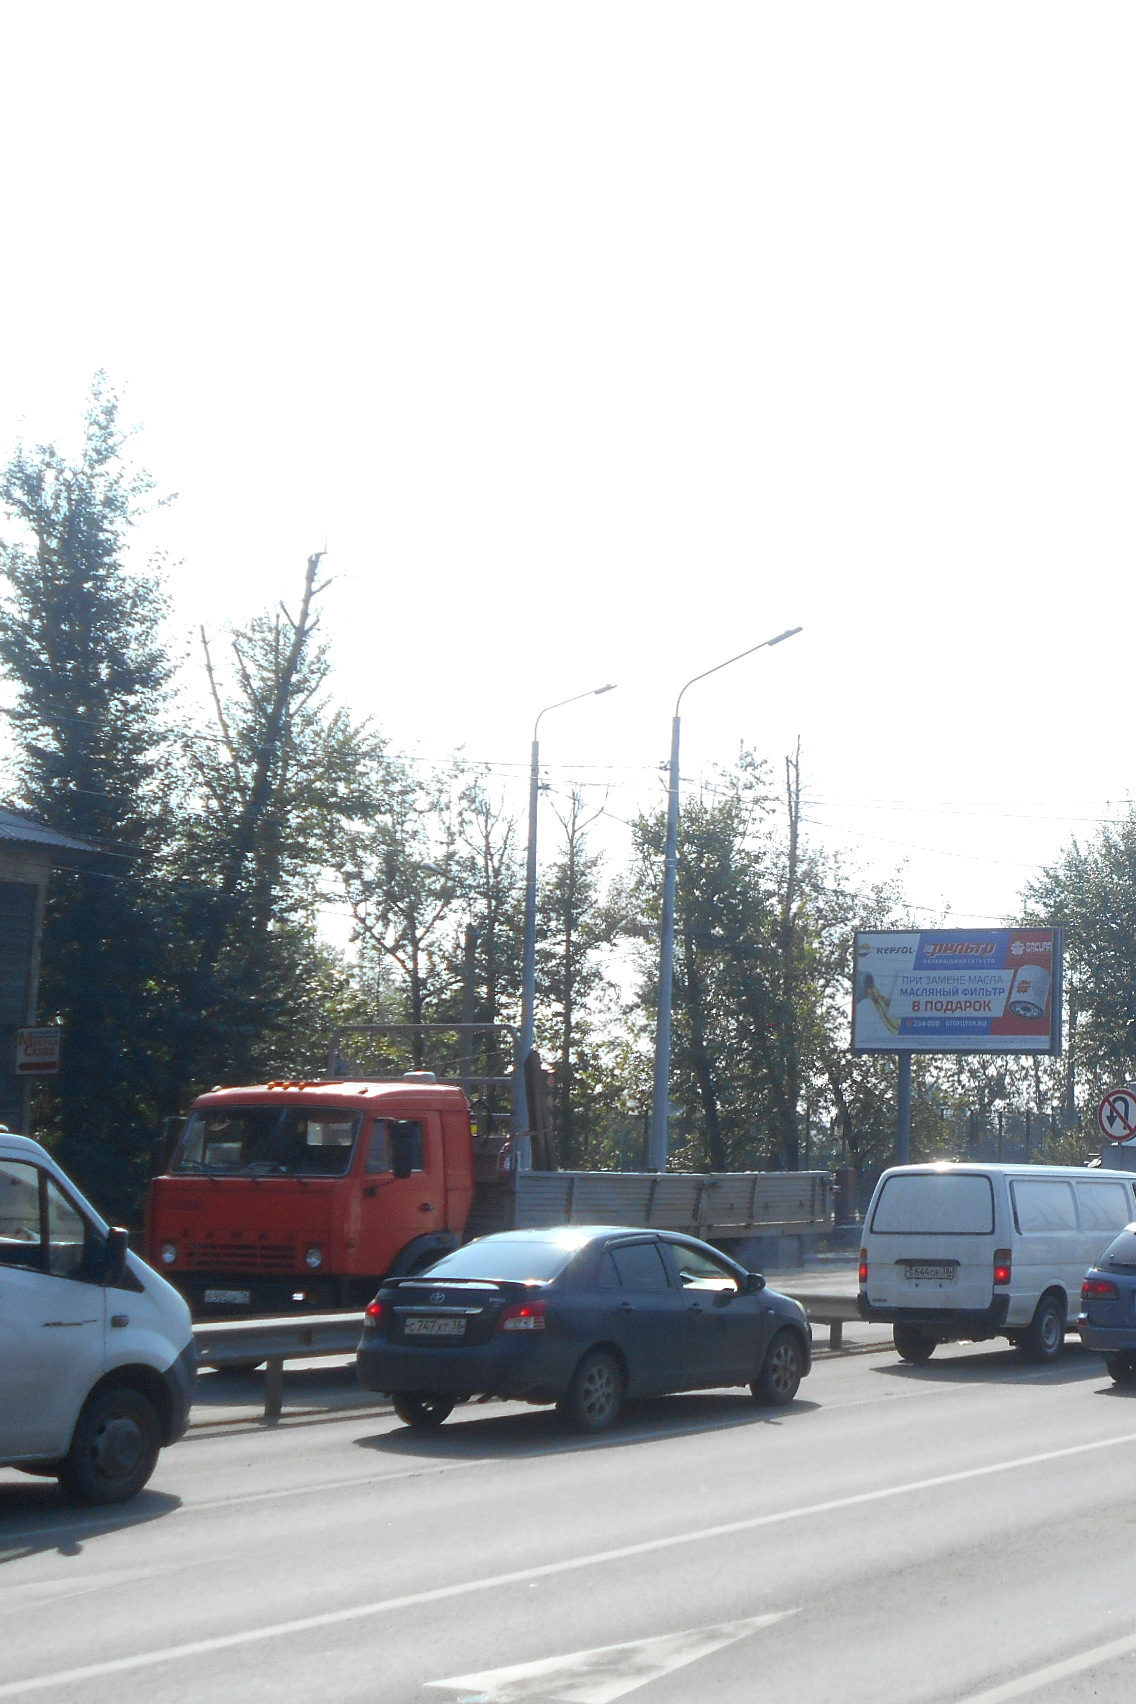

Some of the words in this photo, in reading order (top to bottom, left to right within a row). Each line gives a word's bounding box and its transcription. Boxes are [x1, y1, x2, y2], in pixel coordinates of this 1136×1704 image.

[876, 946, 914, 955] REPSOL
[1026, 941, 1052, 952] SAKURA
[902, 976, 923, 985] ПРИ
[926, 976, 966, 985] ЗАМЕНЕ
[968, 975, 1004, 985] МАСЛА
[900, 986, 959, 997] МАСЛЯНЫЙ
[962, 987, 1005, 997] ФИЛЬТР
[912, 1001, 921, 1011] В
[925, 1000, 992, 1013] ПОДАРОК
